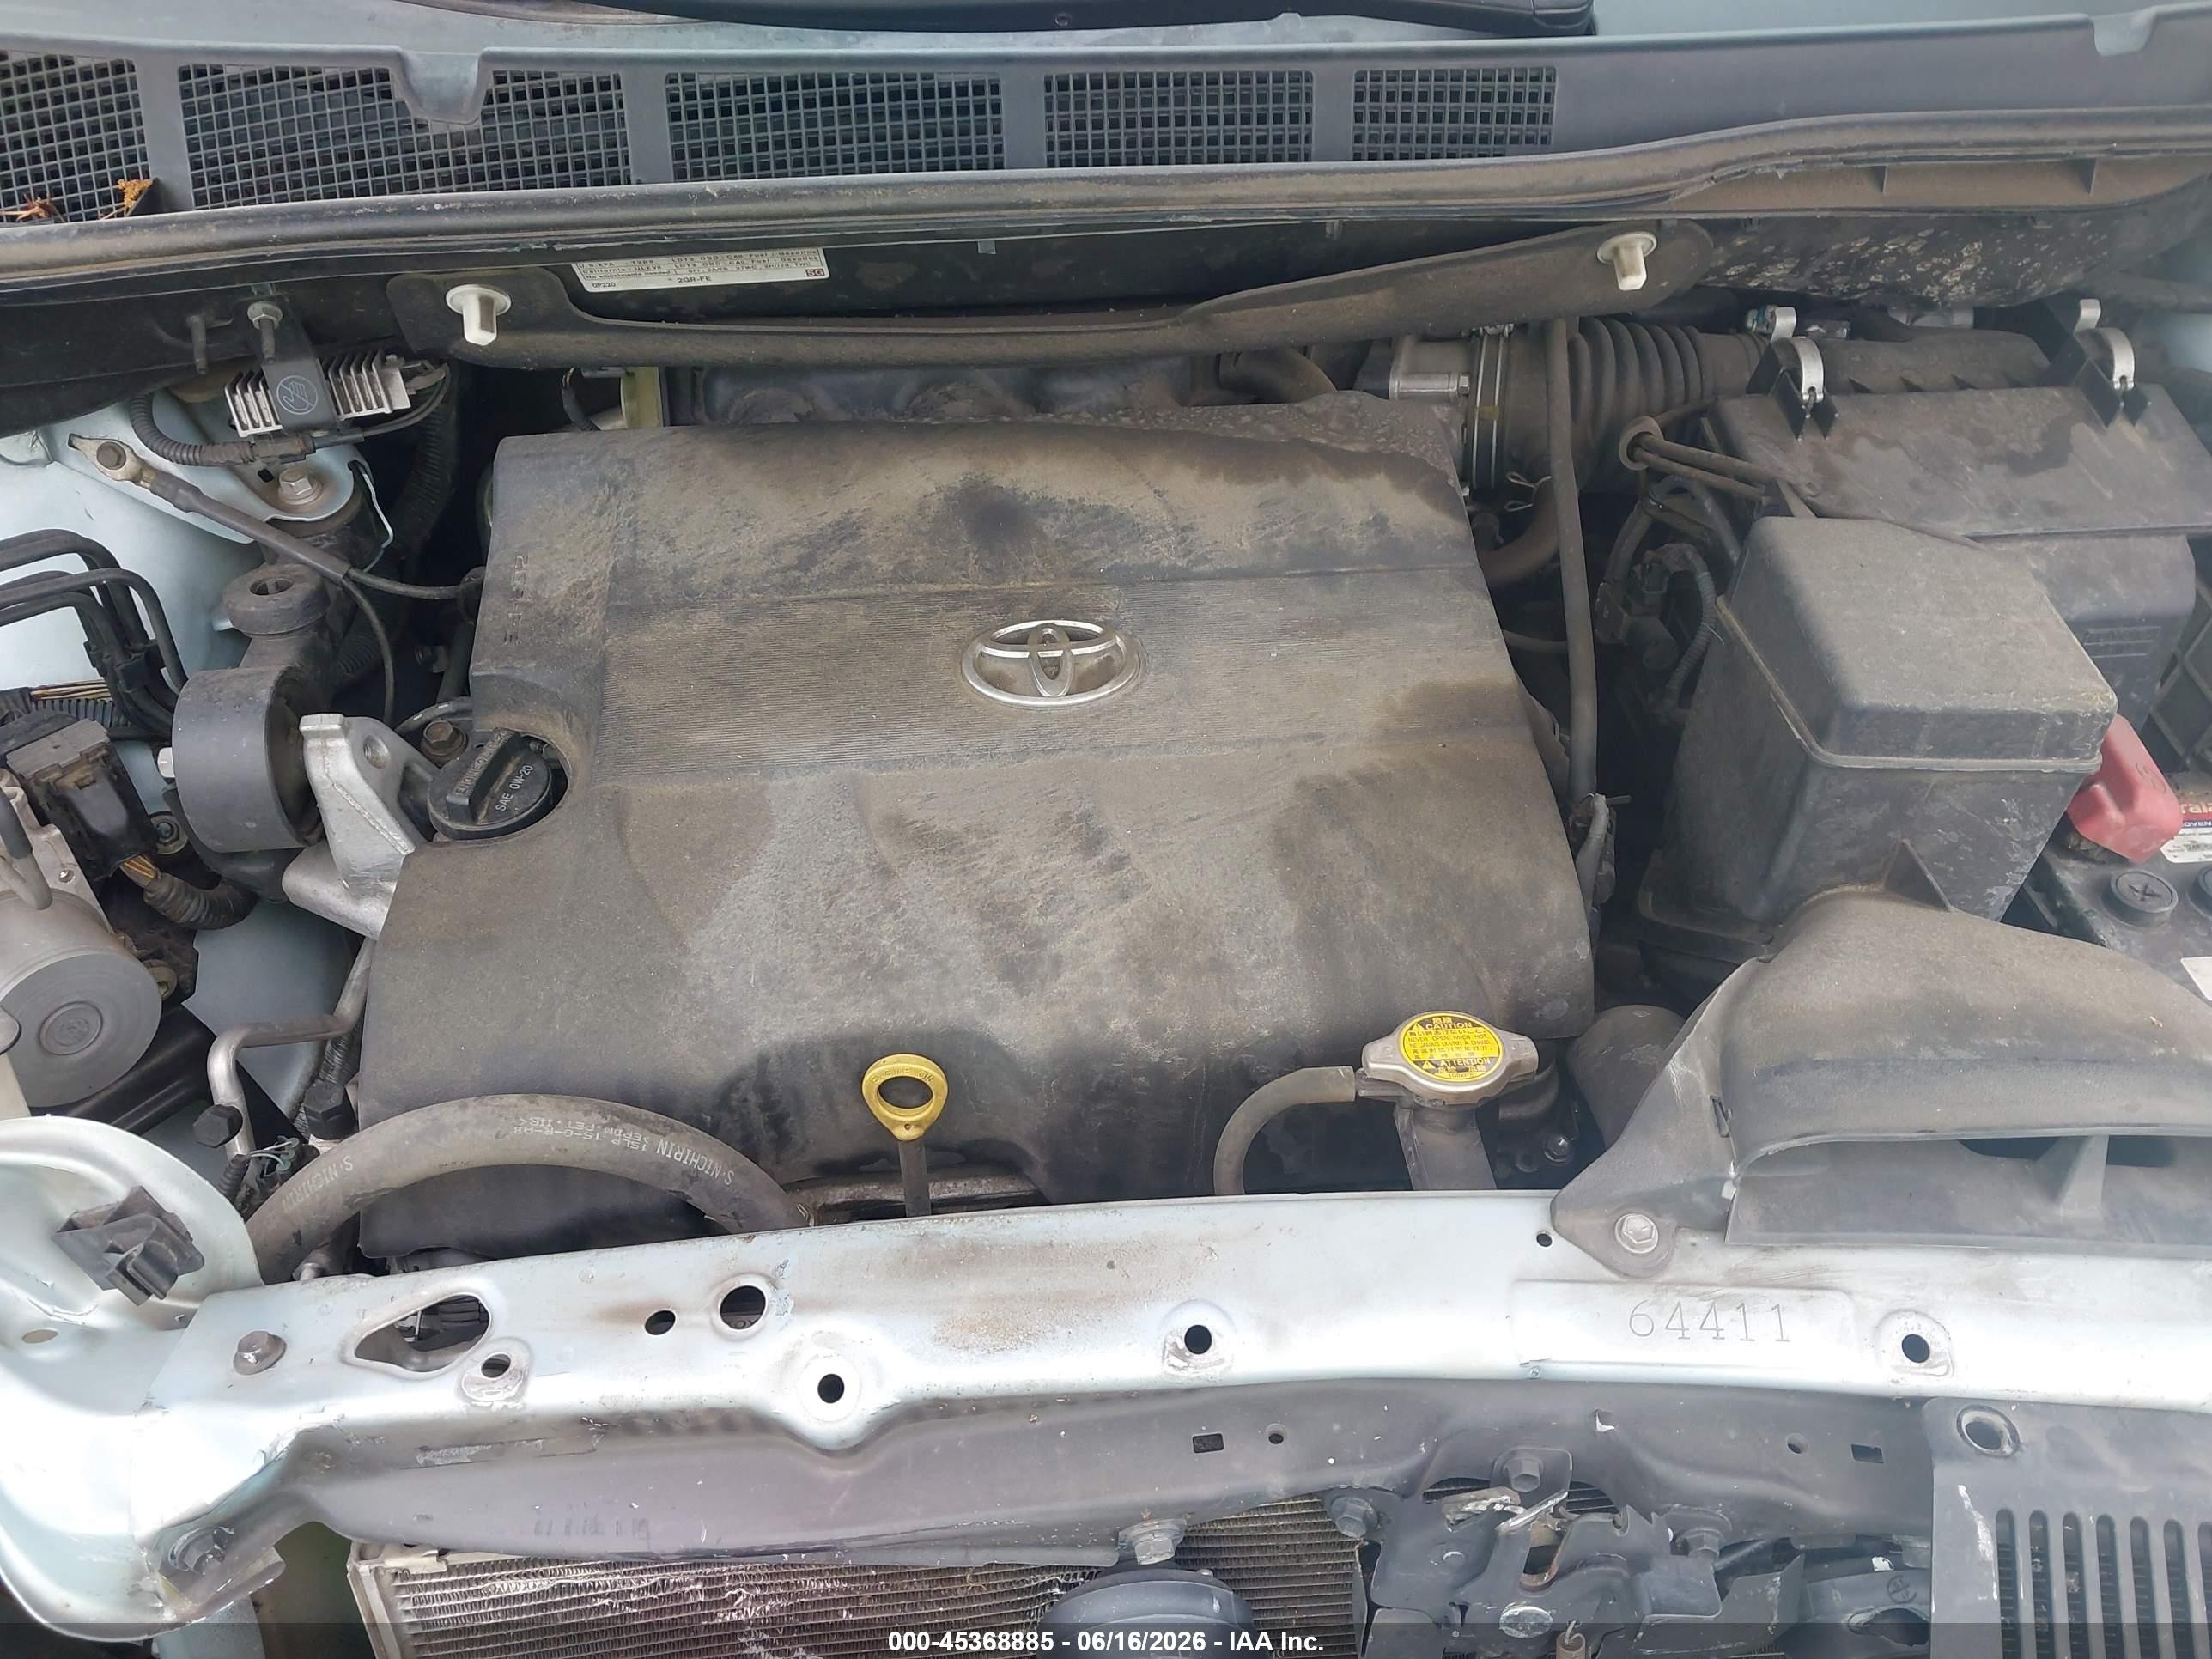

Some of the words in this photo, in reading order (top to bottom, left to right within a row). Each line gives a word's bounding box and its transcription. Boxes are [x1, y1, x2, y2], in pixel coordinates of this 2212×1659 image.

[495, 793, 514, 811] SAE
[1440, 1057, 1491, 1066] ATTENTION
[1629, 1298, 1791, 1342] 64411
